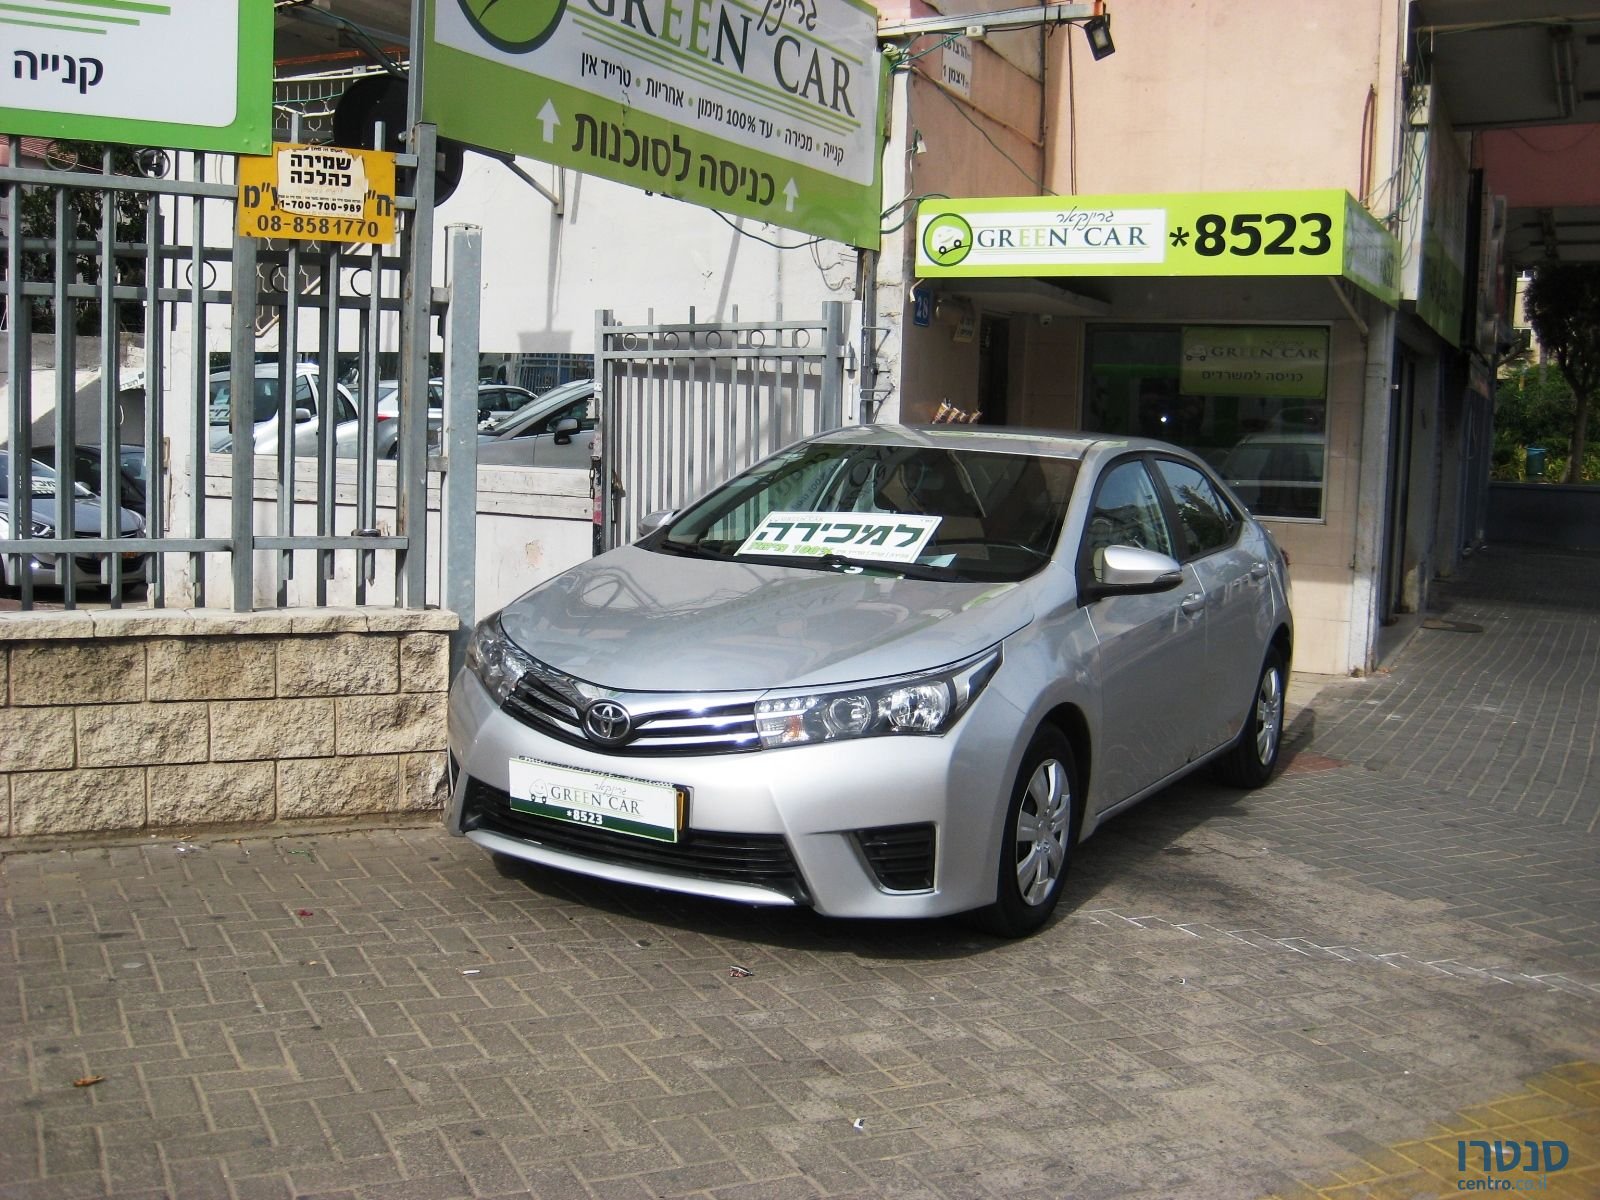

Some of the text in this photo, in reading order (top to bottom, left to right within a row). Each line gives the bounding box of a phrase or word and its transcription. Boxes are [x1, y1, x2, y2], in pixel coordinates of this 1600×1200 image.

[14, 50, 104, 95] קנייה
[774, 35, 855, 118] CAR
[581, 52, 844, 166] קנייה מכירה עד 100% מימון אחריות טרייד אין
[290, 154, 351, 171] שמירה
[571, 113, 776, 206] כניסה לסוכנות
[290, 170, 351, 187] כהלכה
[280, 200, 361, 212] 1-700-700-989
[257, 215, 378, 238] 08-8581770
[977, 226, 1147, 248] GREEN CAR
[1282, 347, 1320, 359] CAR
[1265, 372, 1303, 383] כניסה
[756, 523, 925, 548] למכירה
[551, 786, 640, 815] GREEN CAR
